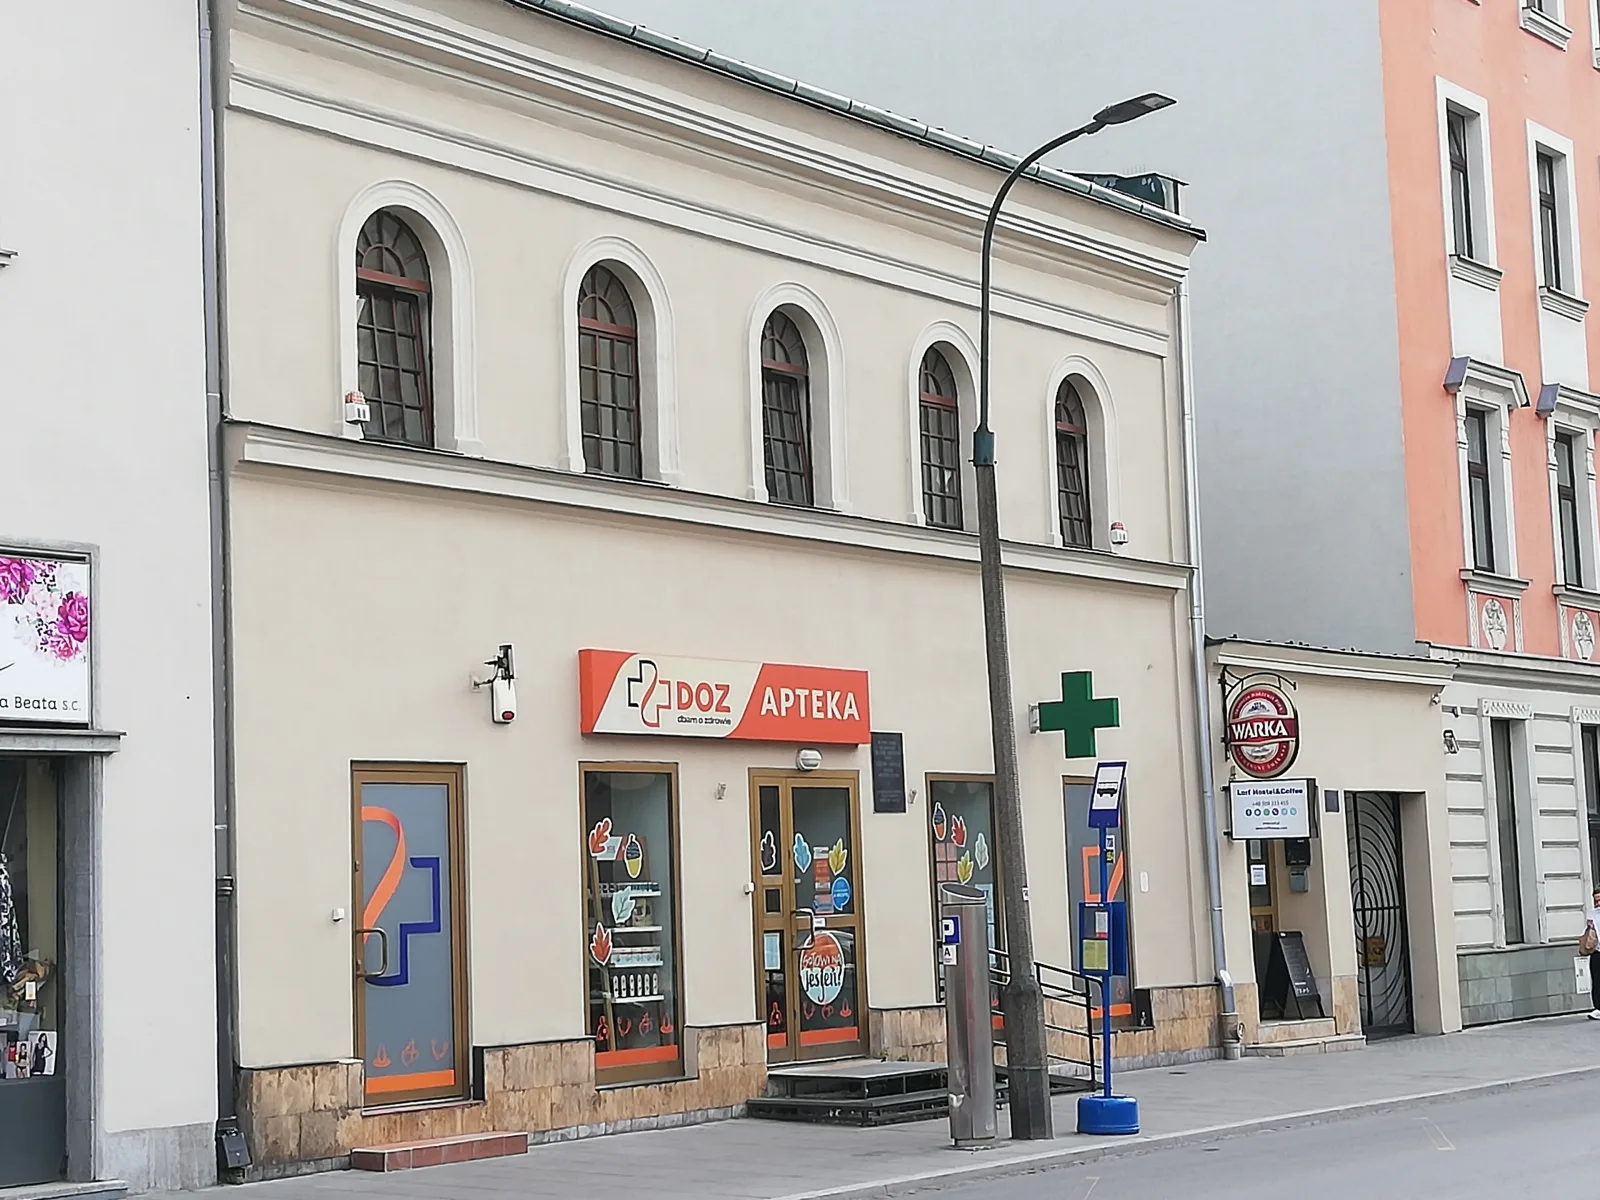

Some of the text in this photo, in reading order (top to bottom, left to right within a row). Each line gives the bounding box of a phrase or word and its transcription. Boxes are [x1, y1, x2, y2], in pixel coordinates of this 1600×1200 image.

[14, 696, 57, 710] Beata
[676, 680, 731, 713] DOZ
[760, 686, 861, 721] APTEKA
[677, 715, 697, 724] dbam
[704, 716, 731, 725] zdrowie
[1231, 720, 1288, 740] WARKA
[942, 919, 955, 943] P
[944, 947, 951, 957] A
